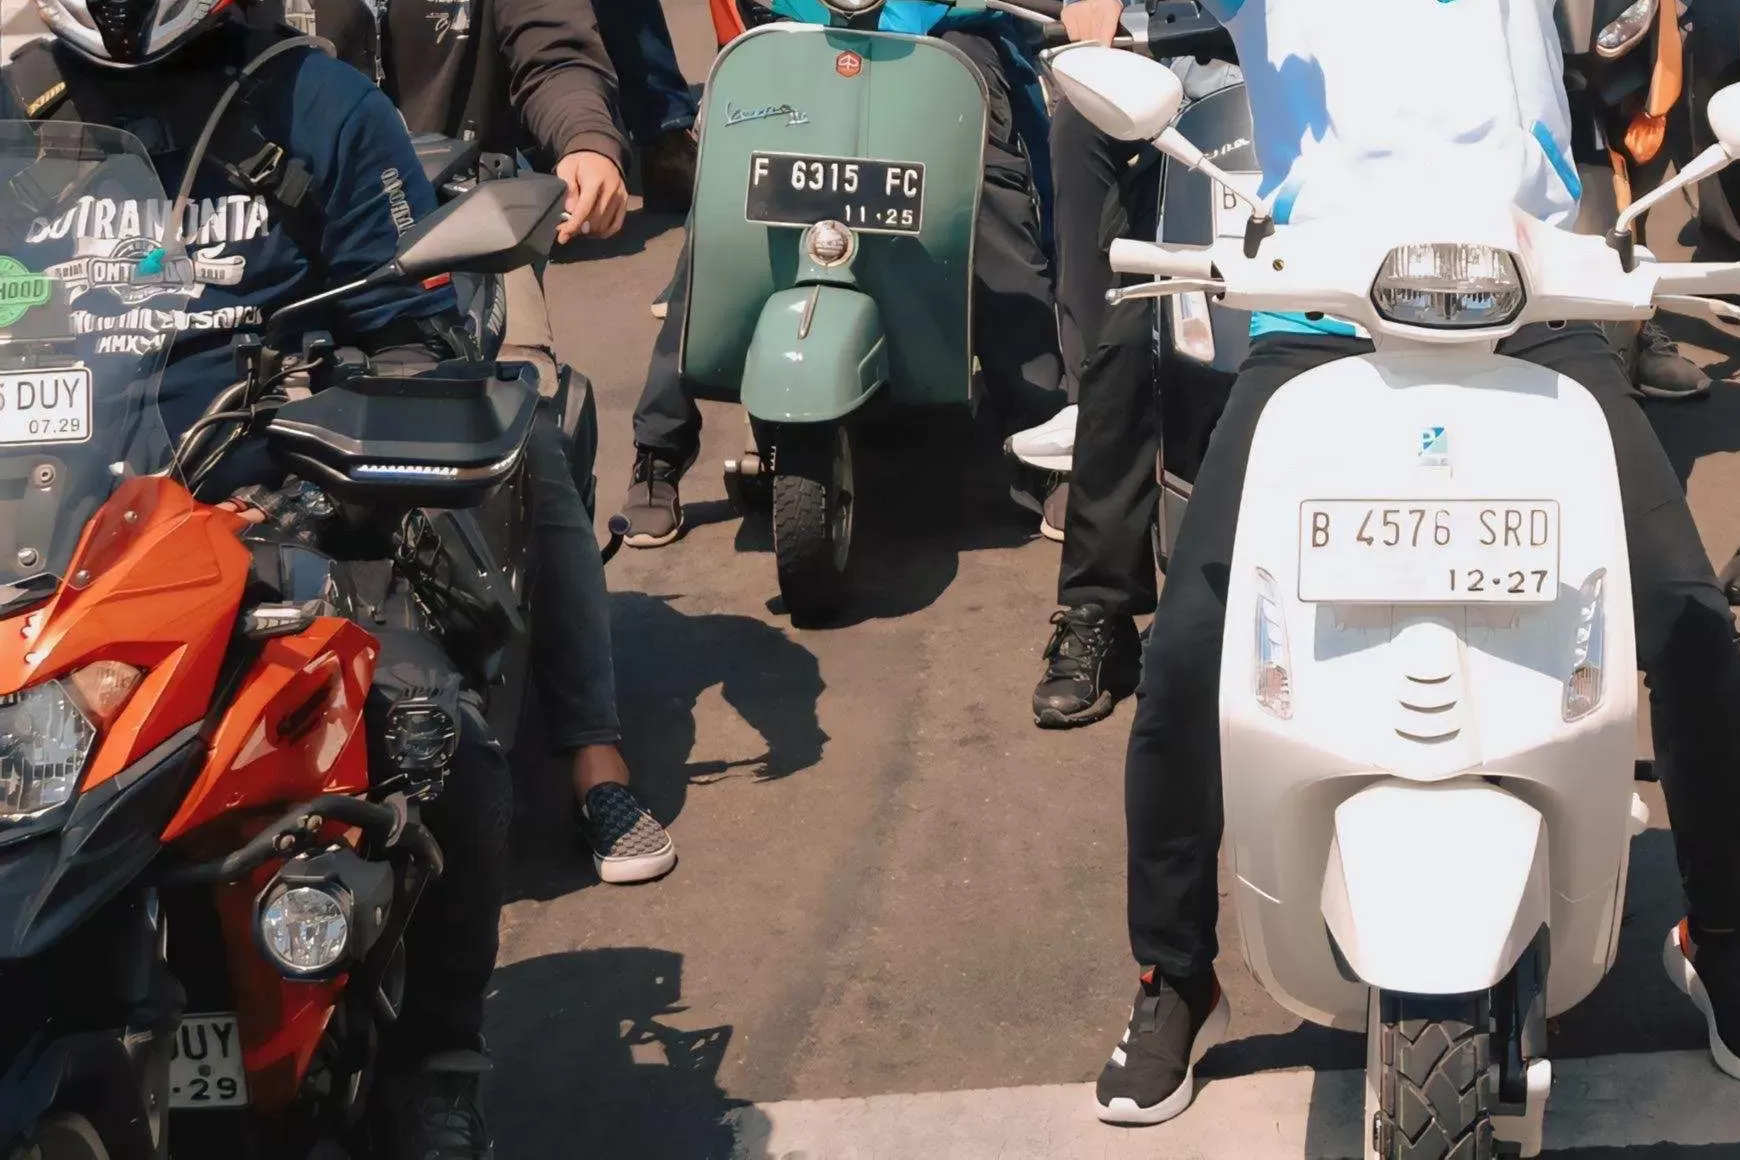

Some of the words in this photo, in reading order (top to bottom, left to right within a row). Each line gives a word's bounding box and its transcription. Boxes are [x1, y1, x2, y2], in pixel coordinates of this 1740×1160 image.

[754, 158, 770, 186] F
[791, 160, 859, 192] 6315
[885, 167, 918, 198] FC
[17, 378, 80, 411] DUY
[28, 418, 81, 434] 07.29
[1311, 511, 1331, 548] B
[1356, 509, 1451, 547] 4576
[1478, 509, 1549, 547] SRD
